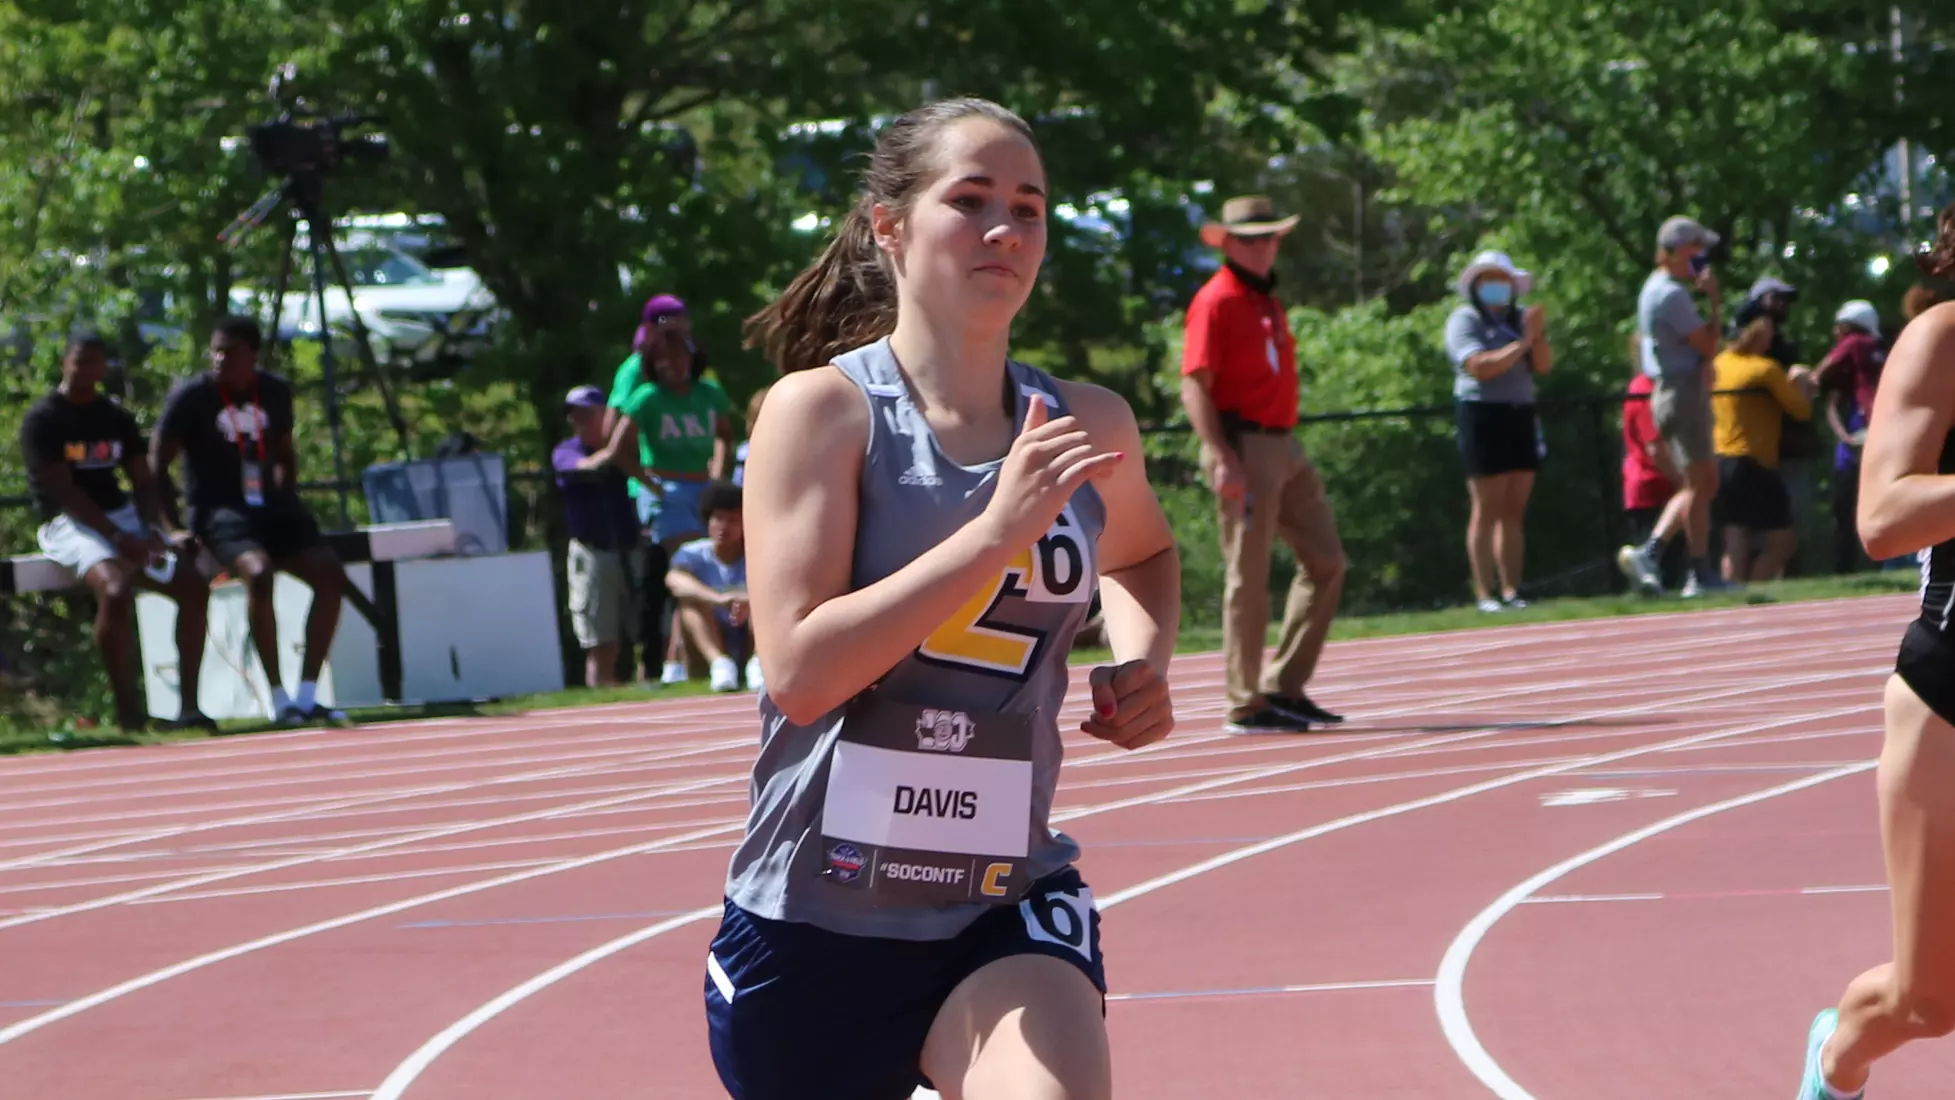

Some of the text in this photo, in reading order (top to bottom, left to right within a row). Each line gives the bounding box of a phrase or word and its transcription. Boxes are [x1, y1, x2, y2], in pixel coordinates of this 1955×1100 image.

[898, 472, 943, 486] adidas
[1039, 512, 1083, 596] 6
[894, 785, 977, 820] DAVIS
[981, 863, 1013, 896] C
[1029, 897, 1083, 947] 6
